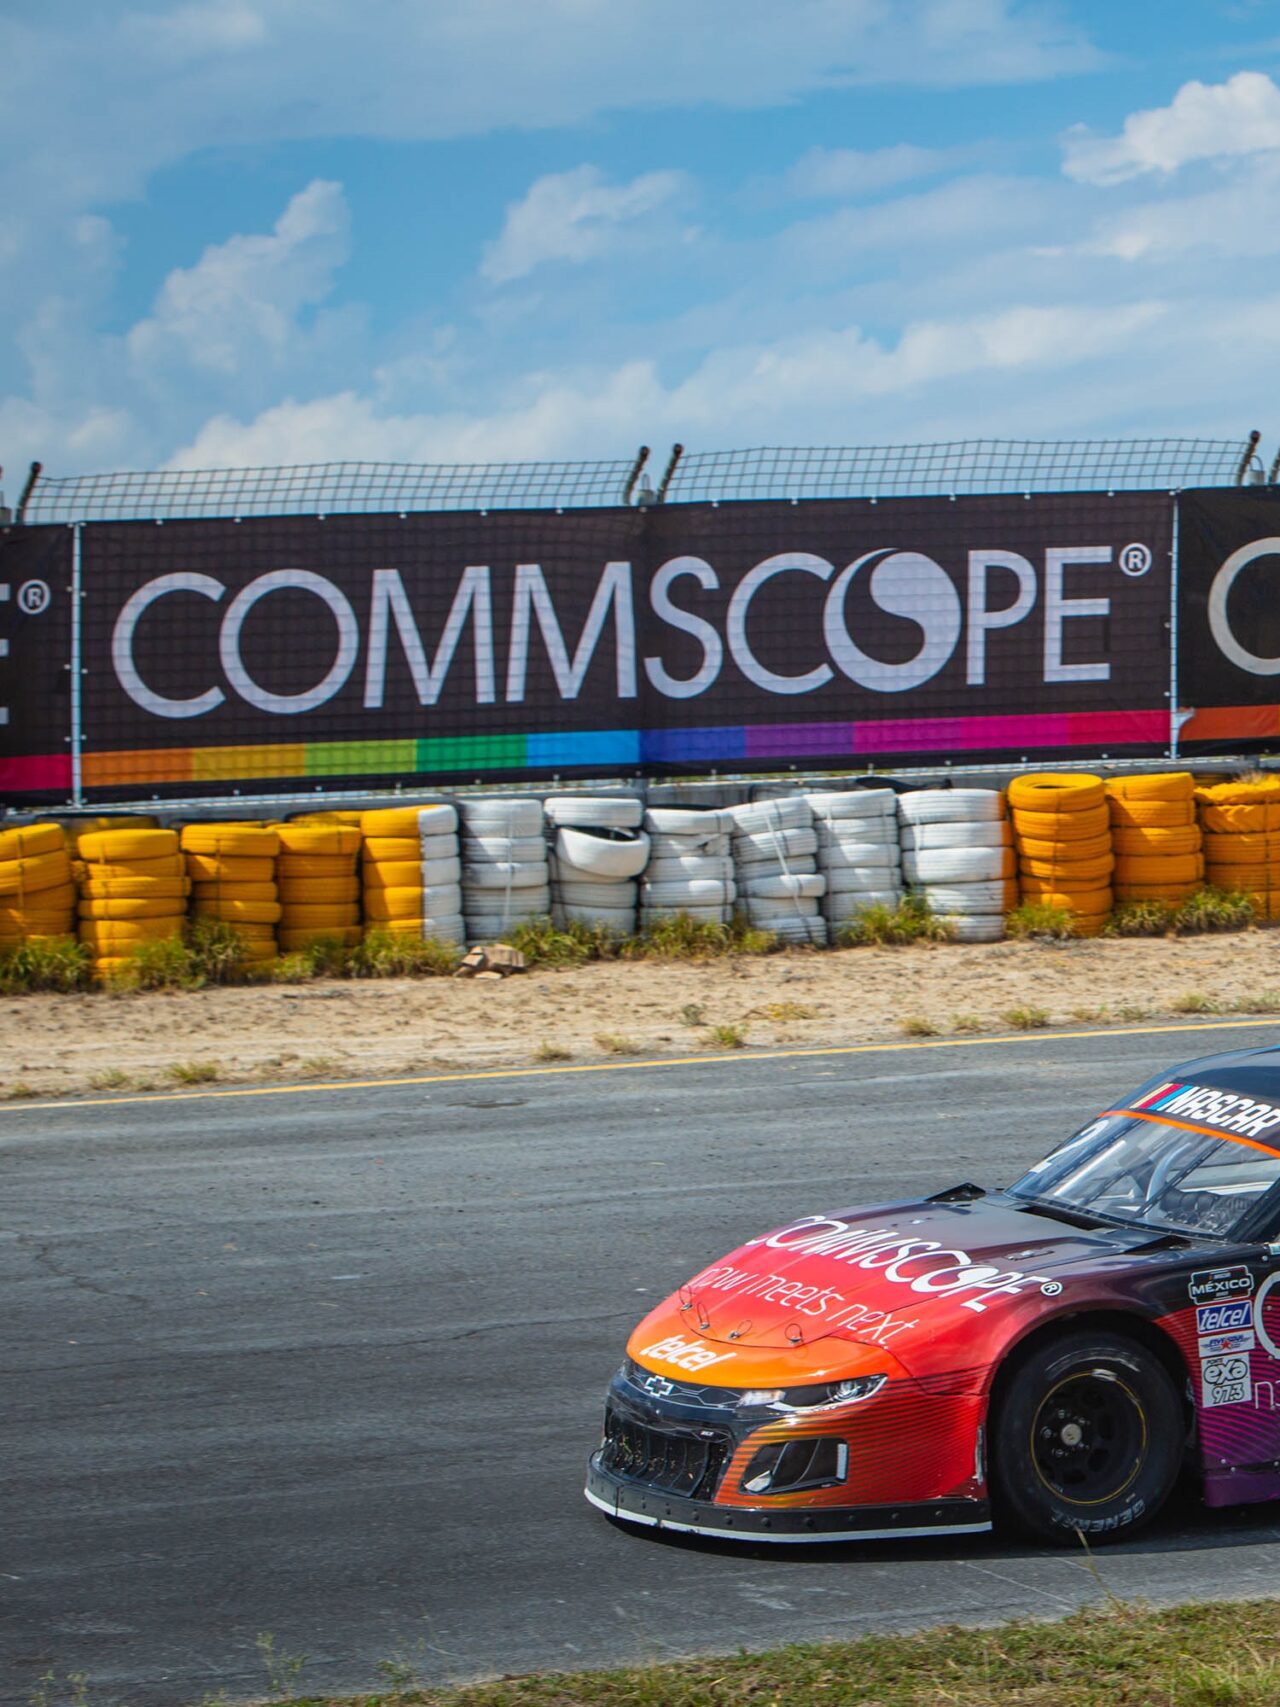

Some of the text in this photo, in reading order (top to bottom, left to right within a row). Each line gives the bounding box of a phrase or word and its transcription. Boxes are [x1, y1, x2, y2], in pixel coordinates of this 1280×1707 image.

[1192, 1278, 1250, 1296] MÉXICO
[746, 1274, 845, 1316] meets
[836, 1305, 920, 1350] next
[1199, 1303, 1249, 1330] telcel
[639, 1334, 735, 1372] telcel
